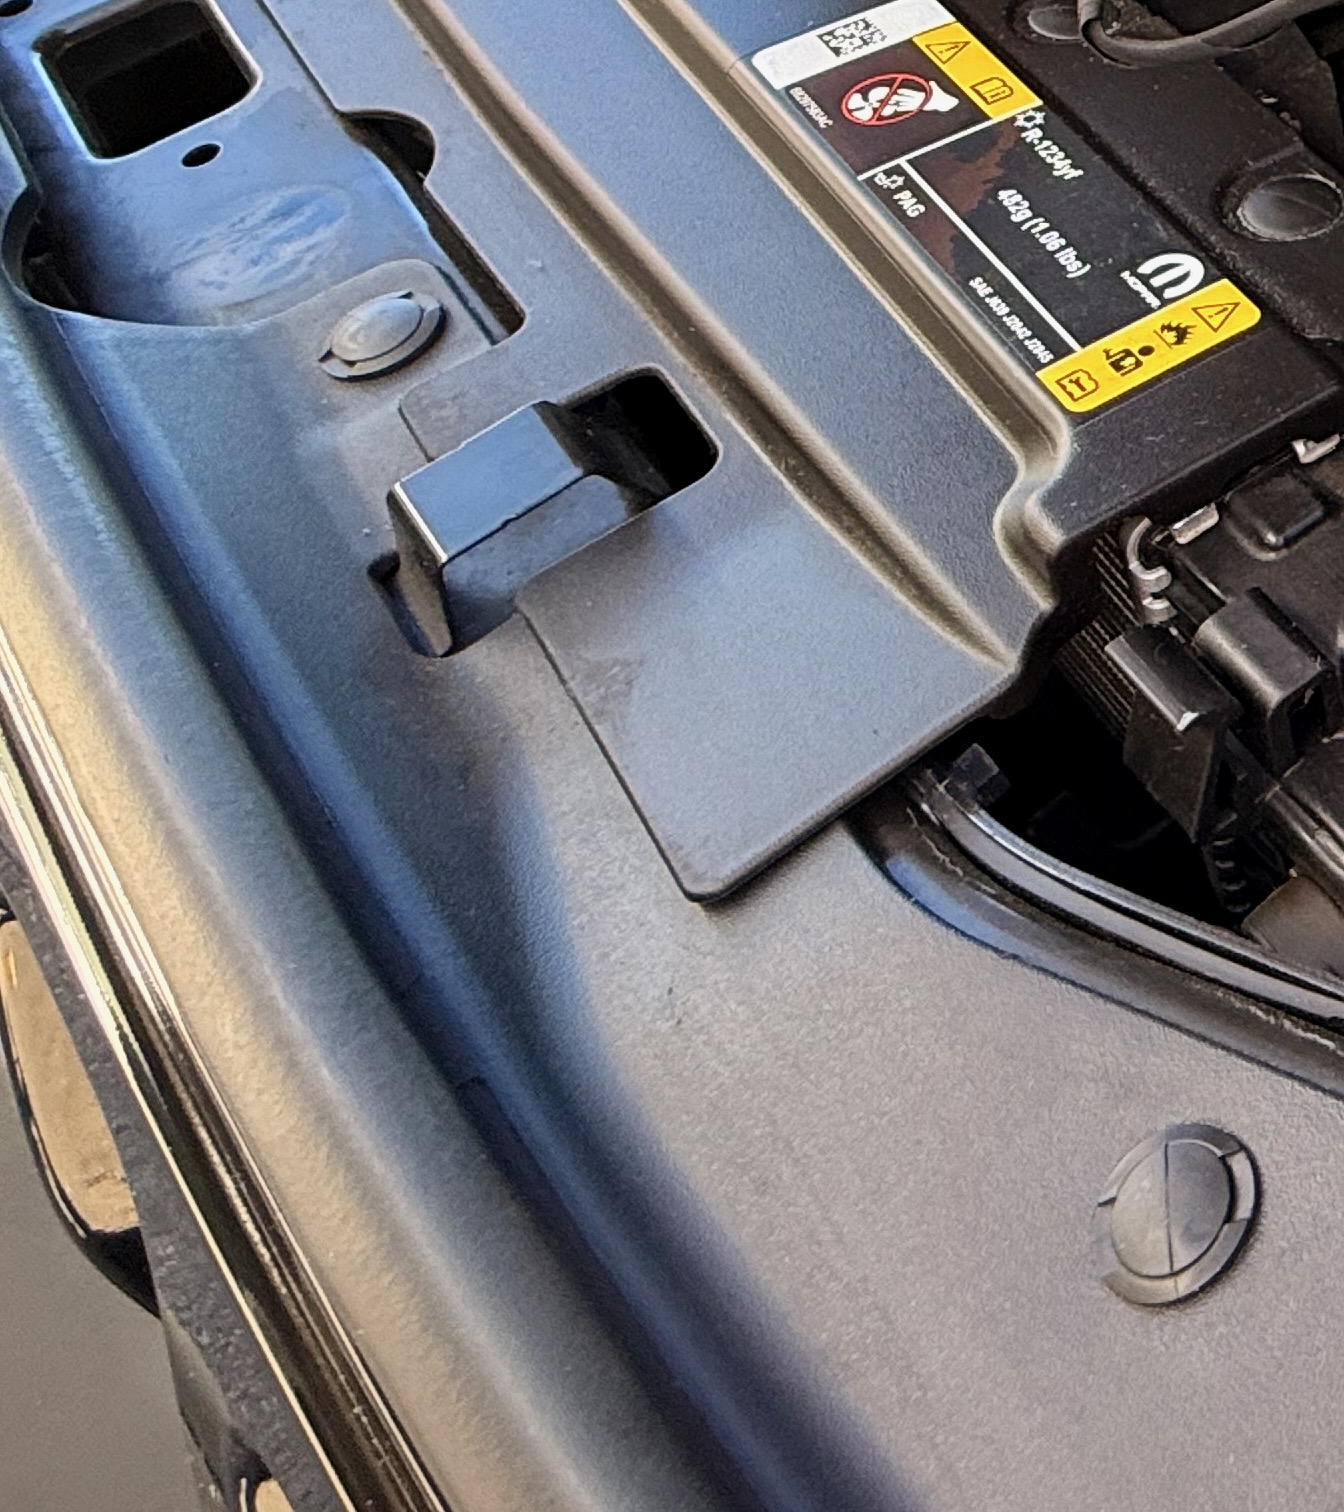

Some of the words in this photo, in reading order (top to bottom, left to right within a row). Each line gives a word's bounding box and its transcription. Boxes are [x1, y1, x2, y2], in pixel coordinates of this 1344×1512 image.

[1020, 127, 1085, 180] R-1234yf
[892, 189, 926, 218] PAG
[997, 188, 1033, 223] 482g
[1020, 217, 1067, 252] (1.06
[1054, 246, 1092, 279] lbs)
[968, 276, 994, 298] SAE
